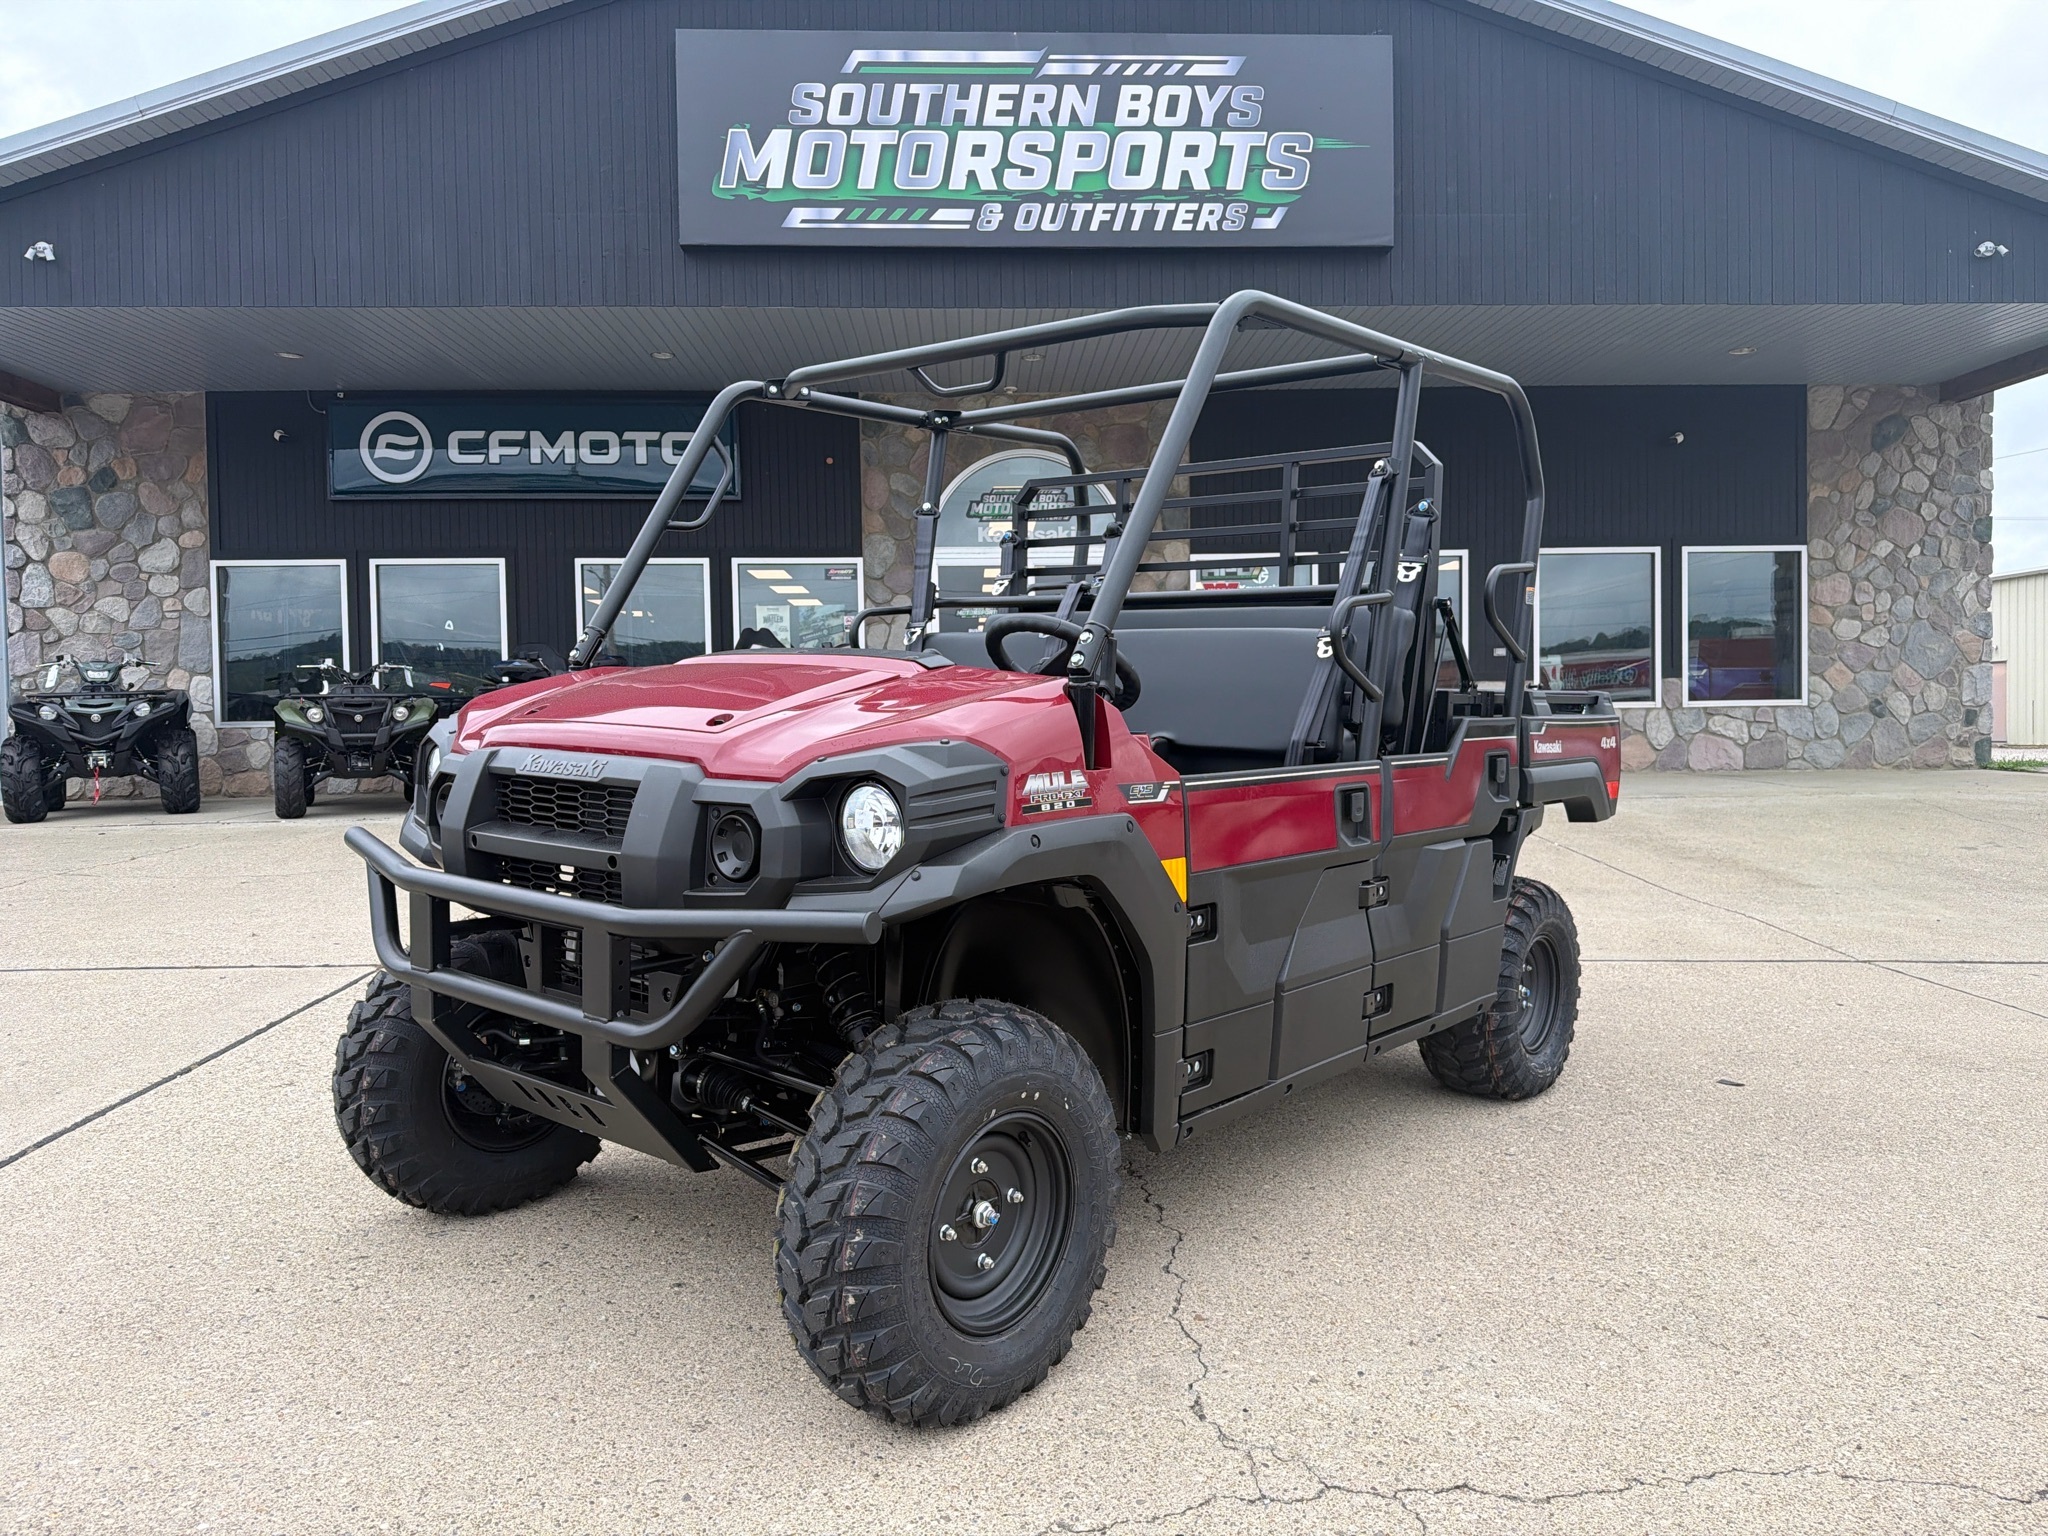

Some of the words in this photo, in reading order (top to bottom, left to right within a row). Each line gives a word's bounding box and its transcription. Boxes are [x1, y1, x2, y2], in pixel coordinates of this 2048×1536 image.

[787, 82, 1104, 128] SOUTHERN
[1114, 82, 1264, 128] BOYS
[718, 127, 1314, 192] MOTORSPORTS
[976, 203, 1003, 232] &
[1013, 202, 1249, 232] OUTFITTERS
[1039, 494, 1066, 503] BOYS
[1533, 740, 1562, 754] Kawasaki
[1600, 736, 1617, 749] 4x4
[518, 754, 609, 779] Kawasaki
[1022, 769, 1090, 796] MULE
